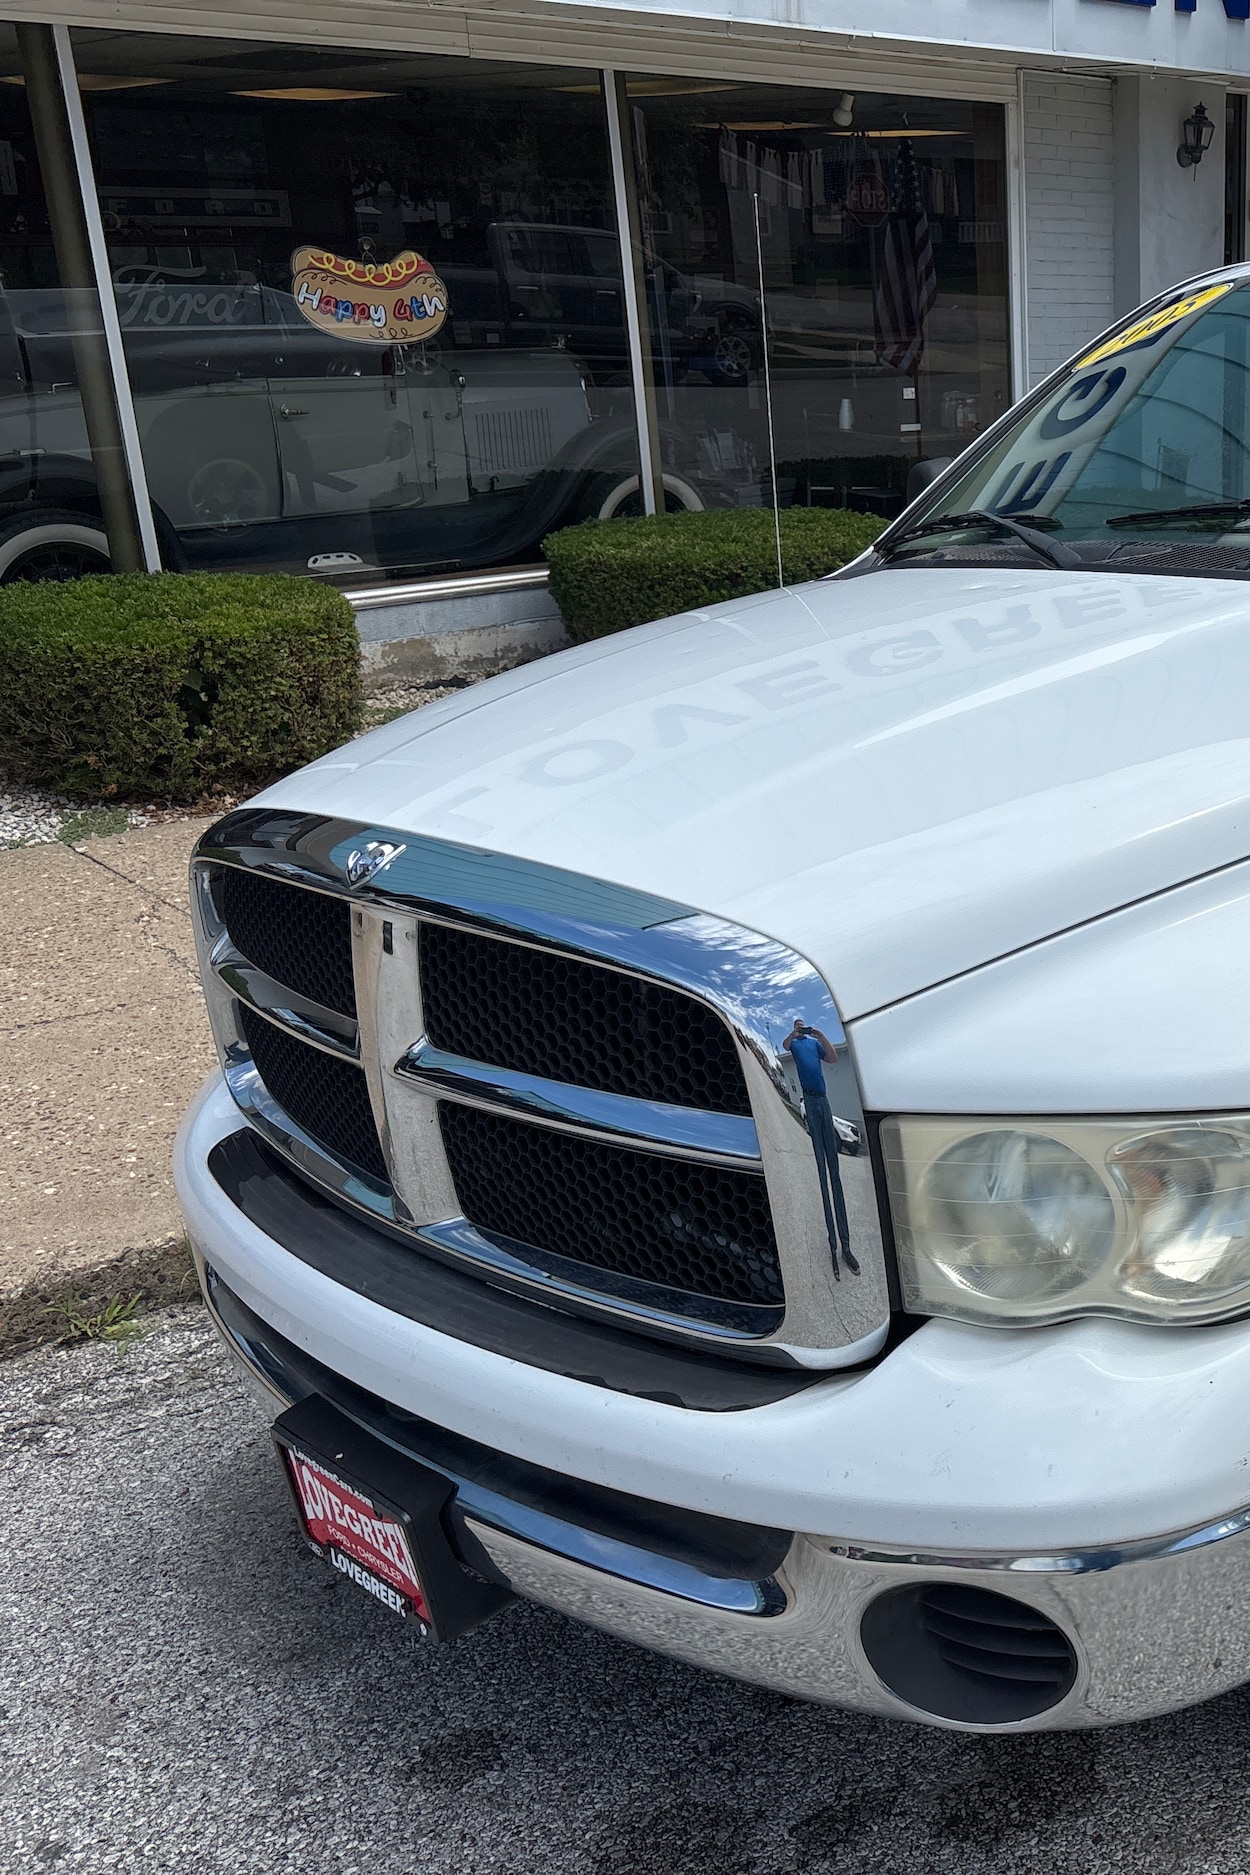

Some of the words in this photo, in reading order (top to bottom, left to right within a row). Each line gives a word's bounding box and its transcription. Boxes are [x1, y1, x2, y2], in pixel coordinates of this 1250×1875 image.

[298, 282, 387, 328] Happy
[393, 293, 446, 322] 4th
[288, 1449, 420, 1591] LOVEGREEN
[327, 1525, 350, 1547] FORD
[357, 1546, 405, 1584] CHRYSLER
[330, 1547, 406, 1618] LOVEGREEN
